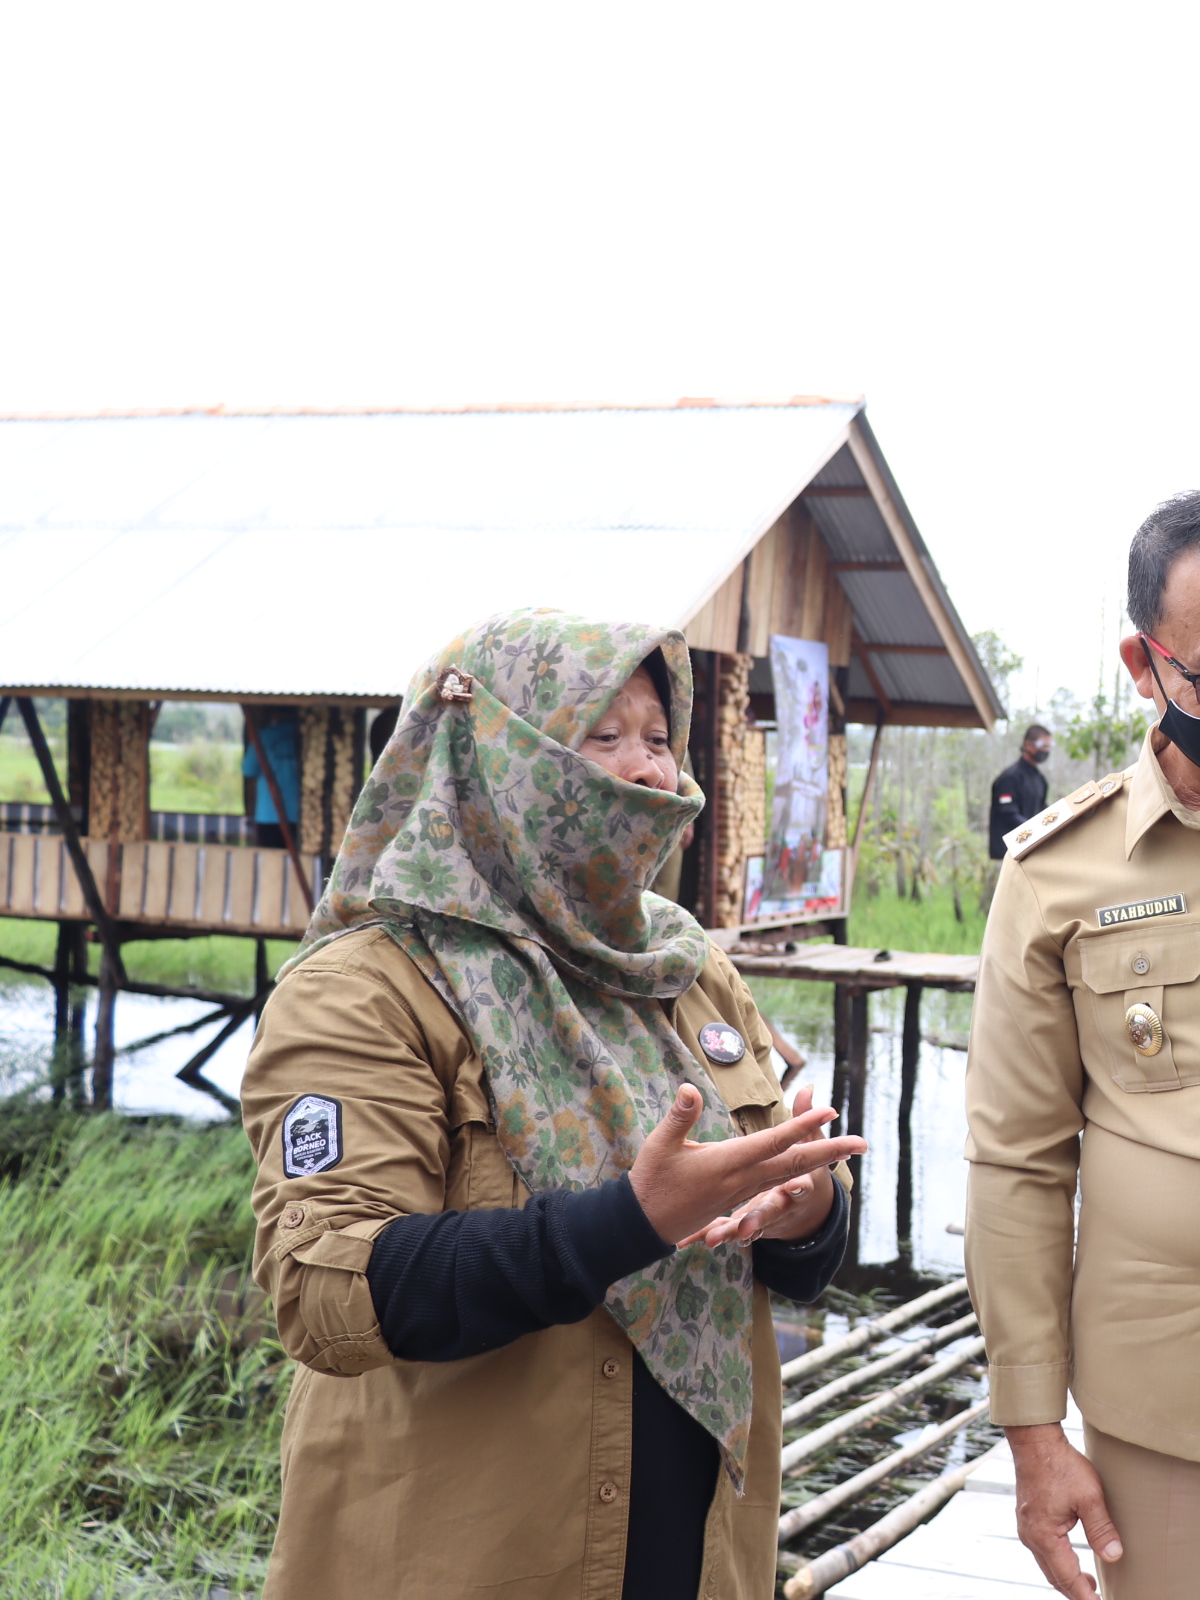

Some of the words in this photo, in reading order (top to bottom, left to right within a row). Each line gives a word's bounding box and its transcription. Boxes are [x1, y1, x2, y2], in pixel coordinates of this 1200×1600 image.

[1104, 898, 1177, 924] SYAHBUDIN
[296, 1132, 322, 1145] BLACK
[293, 1139, 326, 1155] BORNEO
